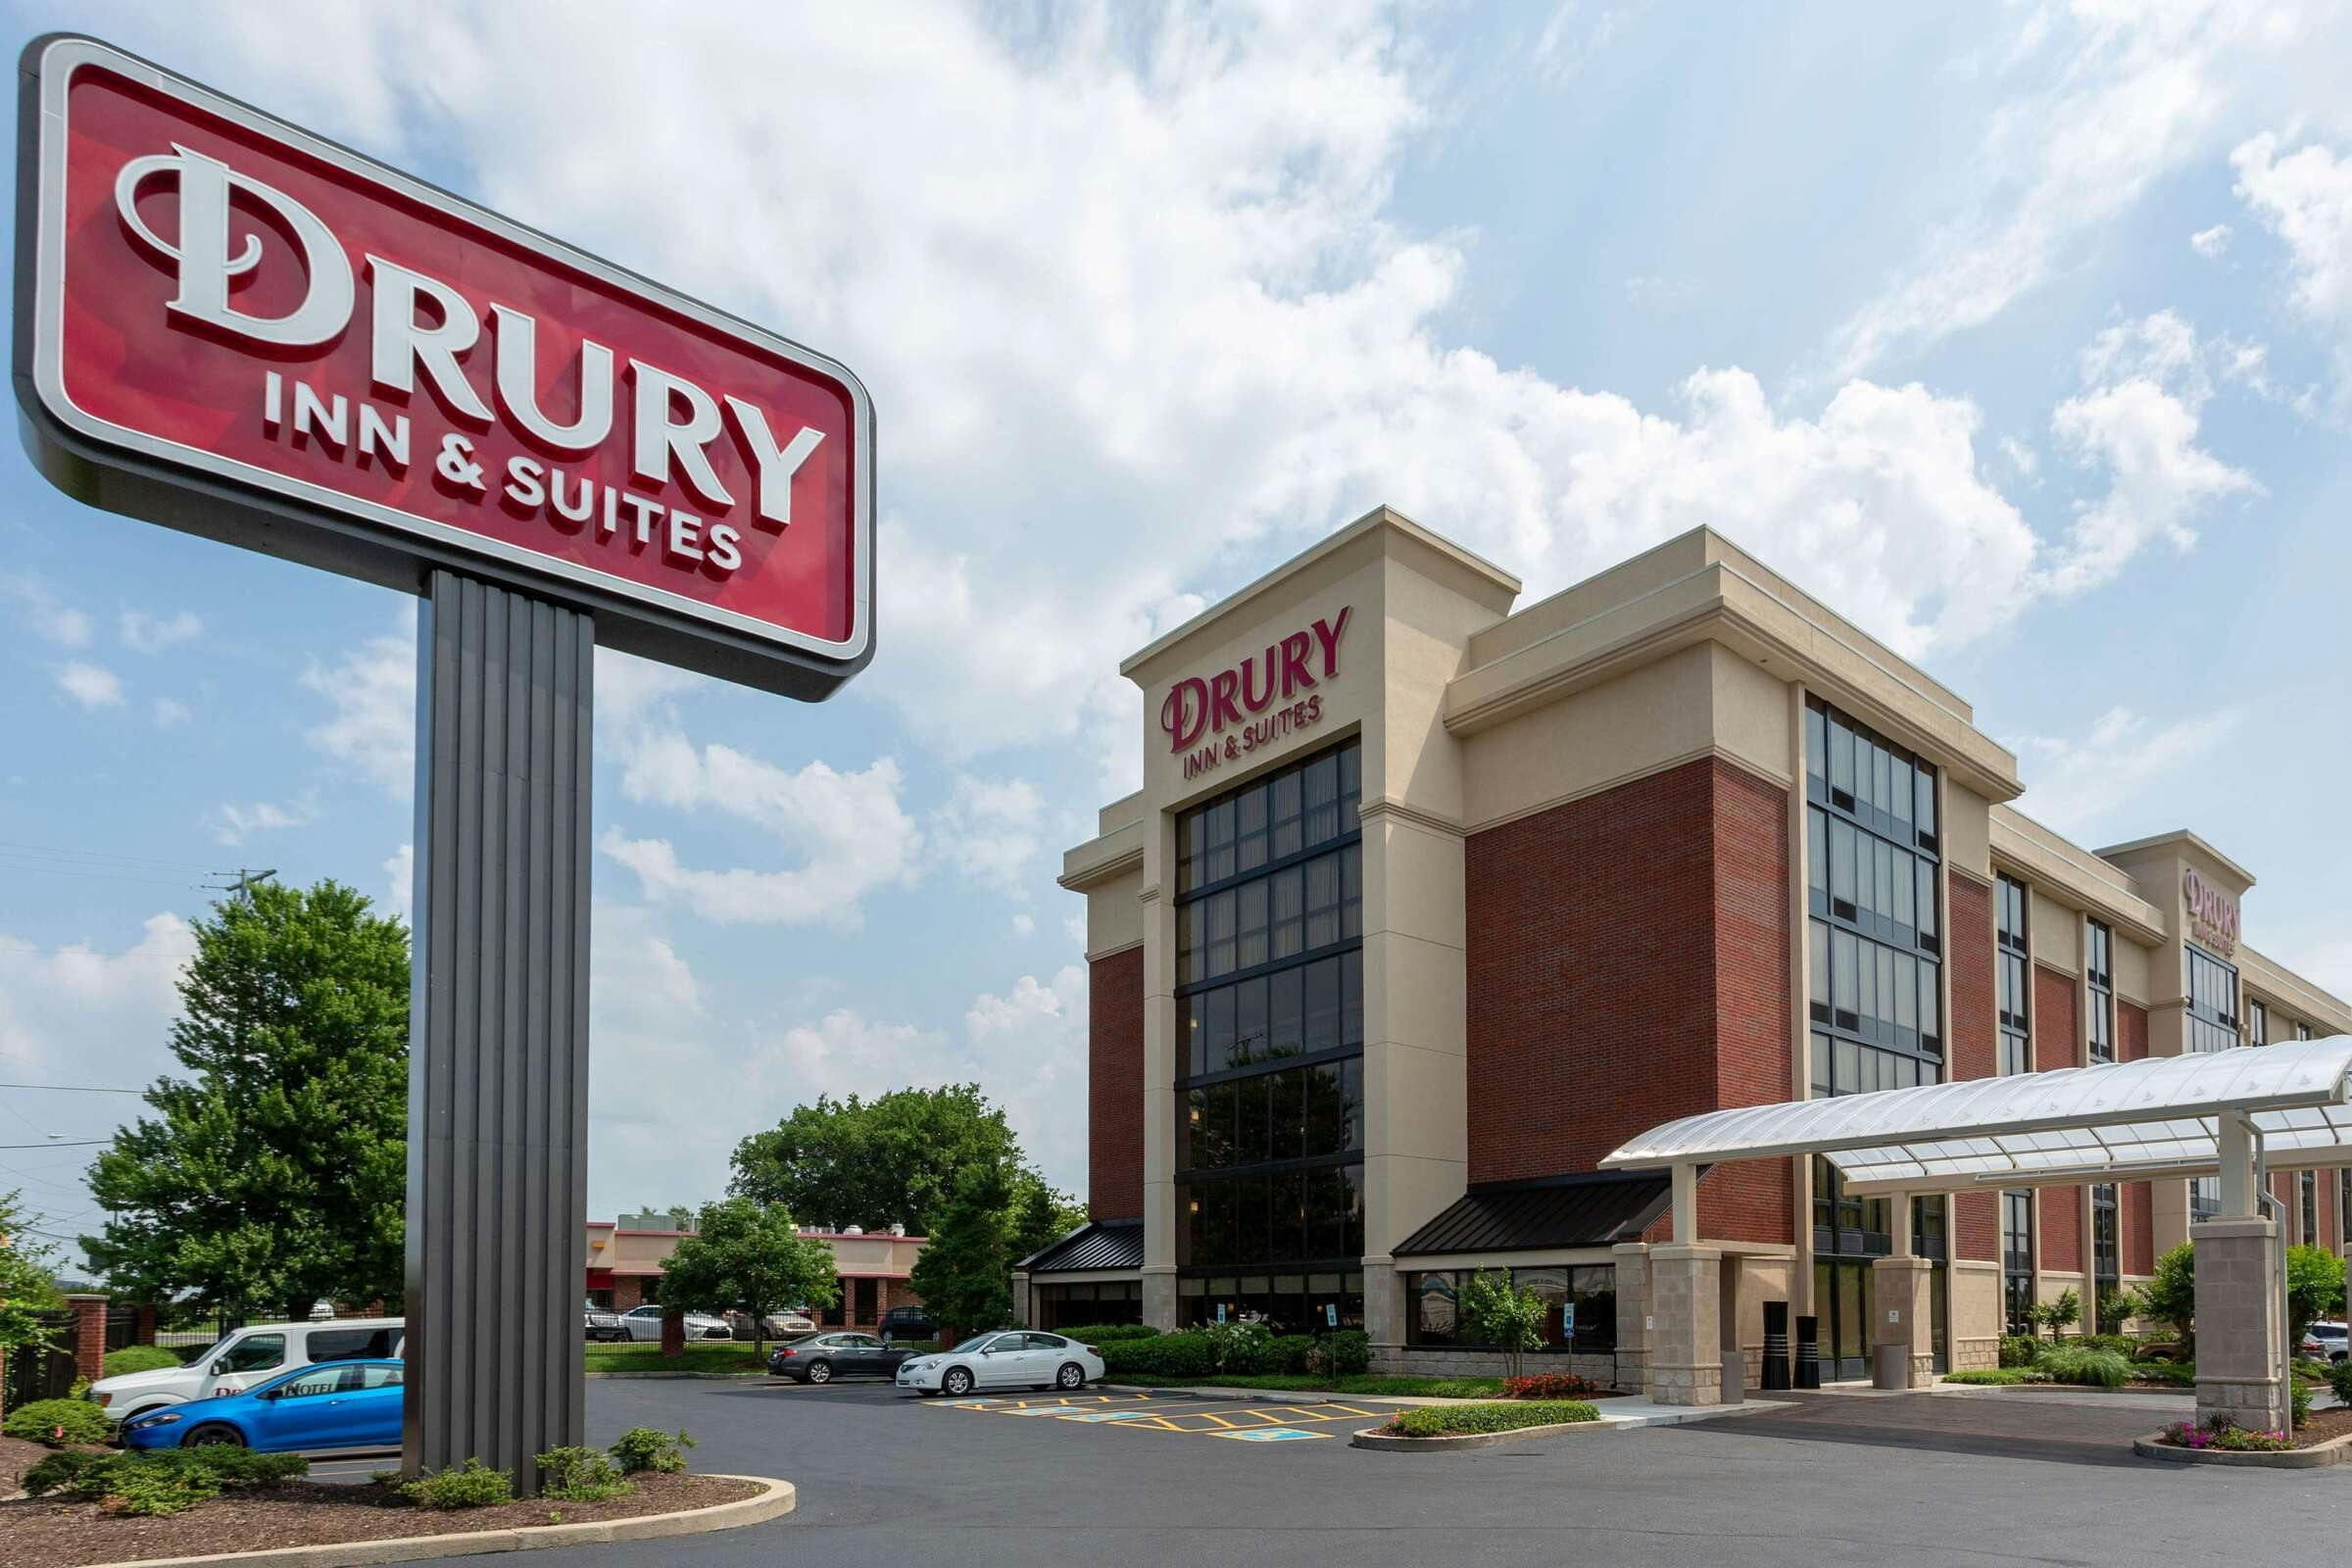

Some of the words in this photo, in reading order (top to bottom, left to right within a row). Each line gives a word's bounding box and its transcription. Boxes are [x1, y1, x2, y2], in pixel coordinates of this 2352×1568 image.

[115, 140, 827, 525] DRURY
[265, 369, 411, 467] INN
[433, 432, 488, 491] &
[504, 455, 743, 571] SUITES
[1160, 604, 1352, 754] DRURY
[1183, 741, 1219, 780] INN
[1224, 734, 1241, 760] &
[1243, 694, 1322, 752] SUITES
[2183, 867, 2241, 939] DRURY
